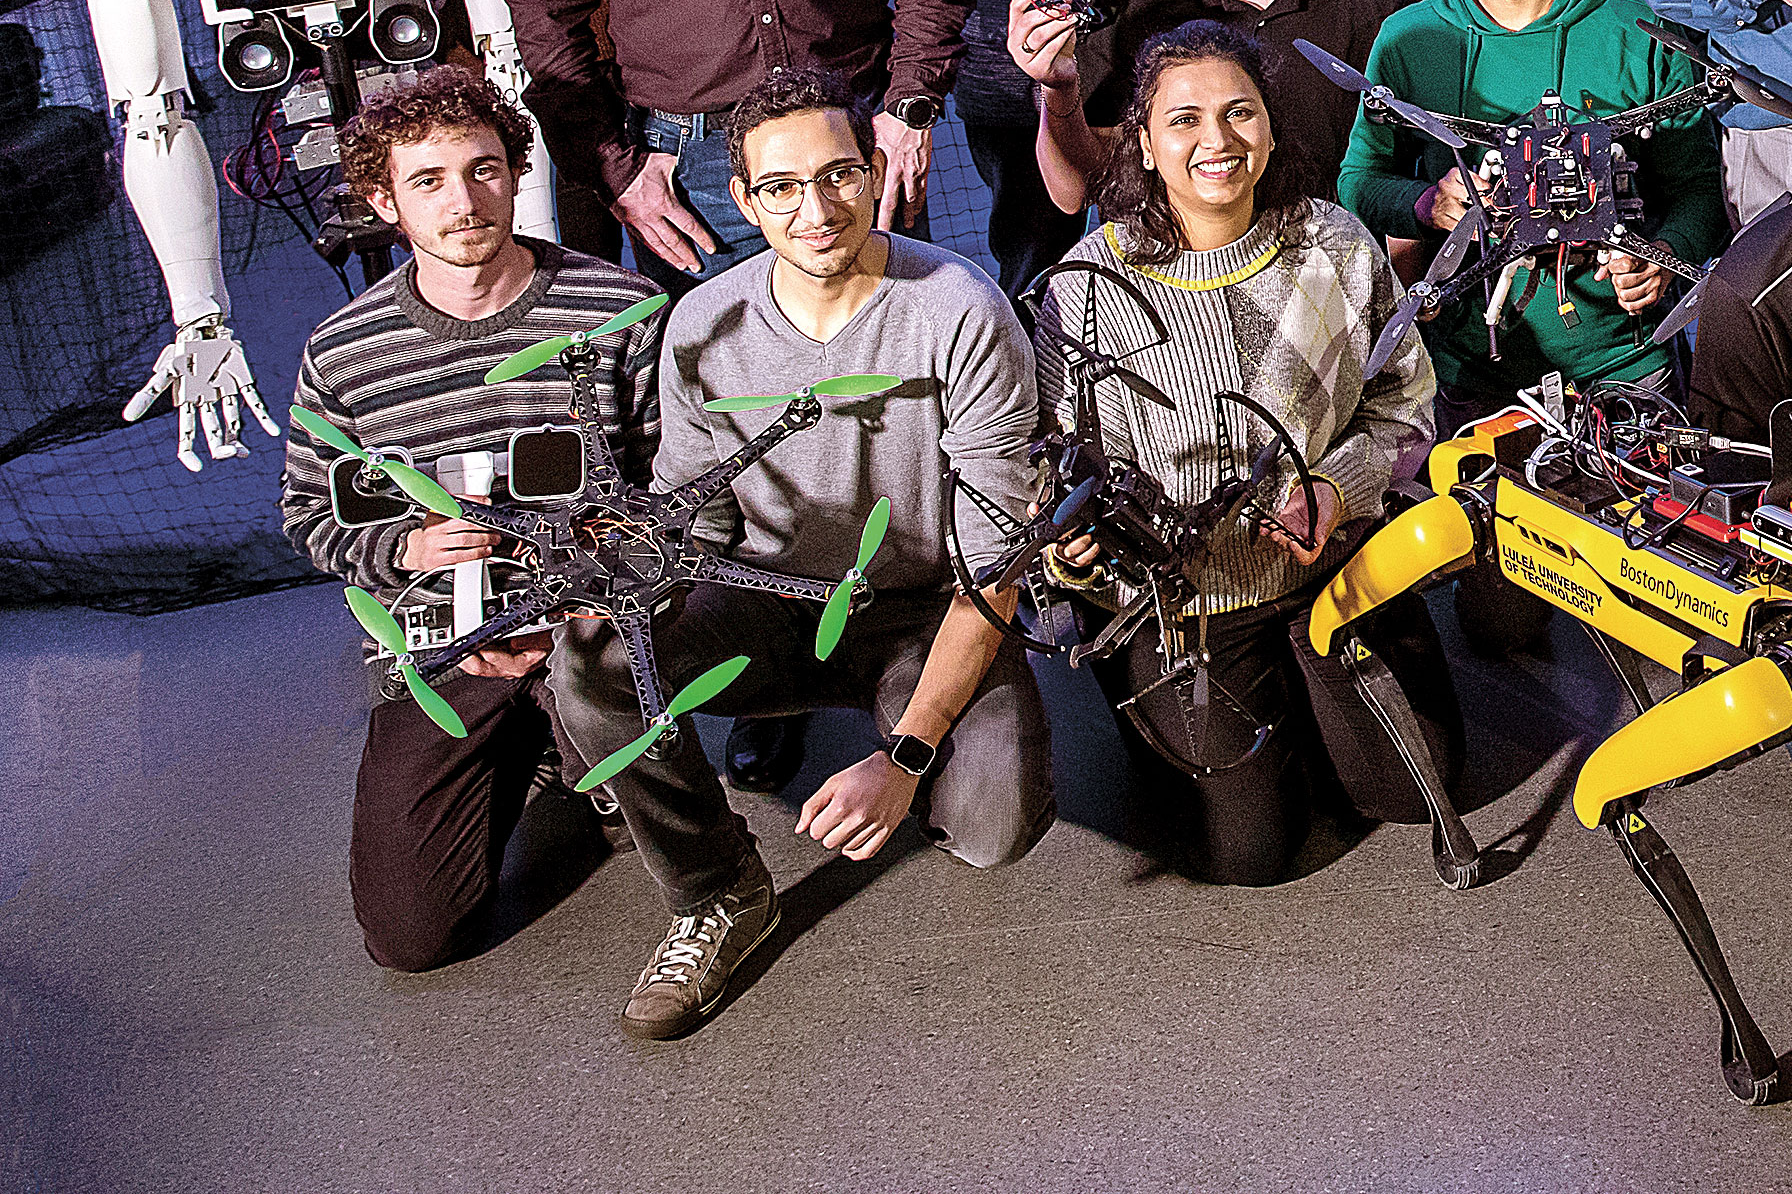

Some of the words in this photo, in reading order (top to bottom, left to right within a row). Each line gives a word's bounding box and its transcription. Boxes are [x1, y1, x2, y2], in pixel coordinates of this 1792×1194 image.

[1502, 544, 1537, 576] LULEÅ
[1538, 563, 1603, 607] UNIVERSITY
[1504, 559, 1520, 575] OF
[1520, 567, 1597, 617] TECHNOLOGY
